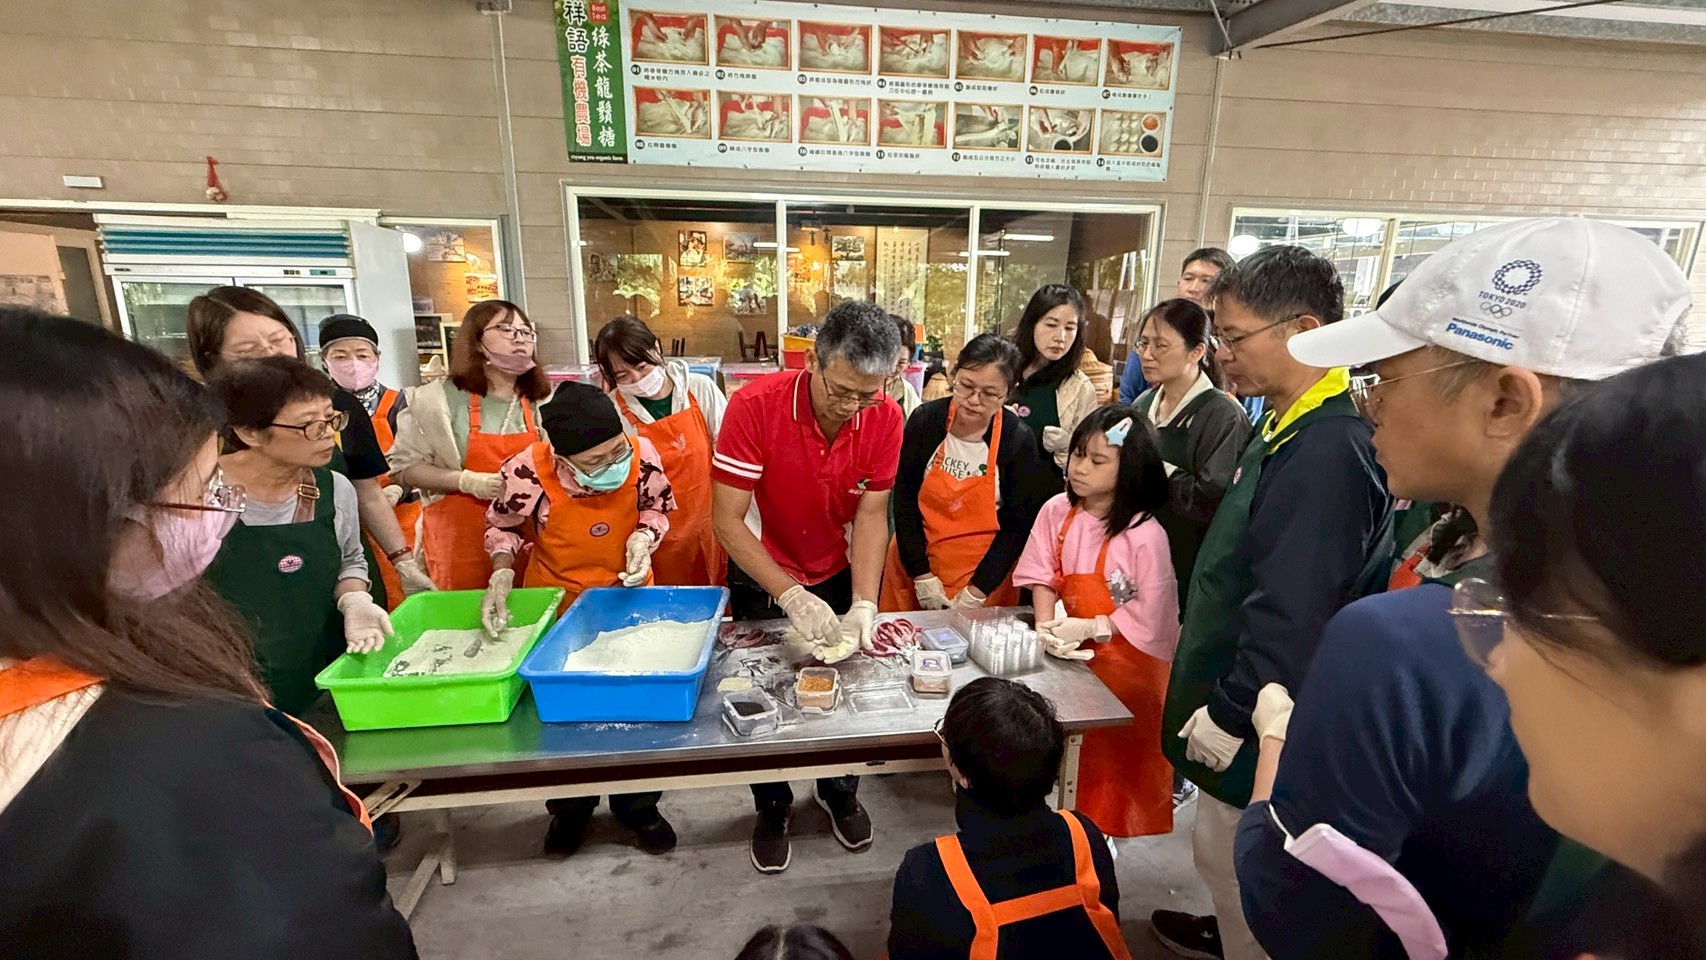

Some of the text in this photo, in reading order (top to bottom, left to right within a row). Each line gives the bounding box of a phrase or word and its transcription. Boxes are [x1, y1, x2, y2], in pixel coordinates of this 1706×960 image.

[592, 12, 607, 20] Tea
[591, 25, 617, 148] 綠茶龍鬚糖
[1478, 290, 1527, 309] TOKYO 2020
[1445, 322, 1514, 350] Panasonic
[1478, 323, 1499, 333] Olympic
